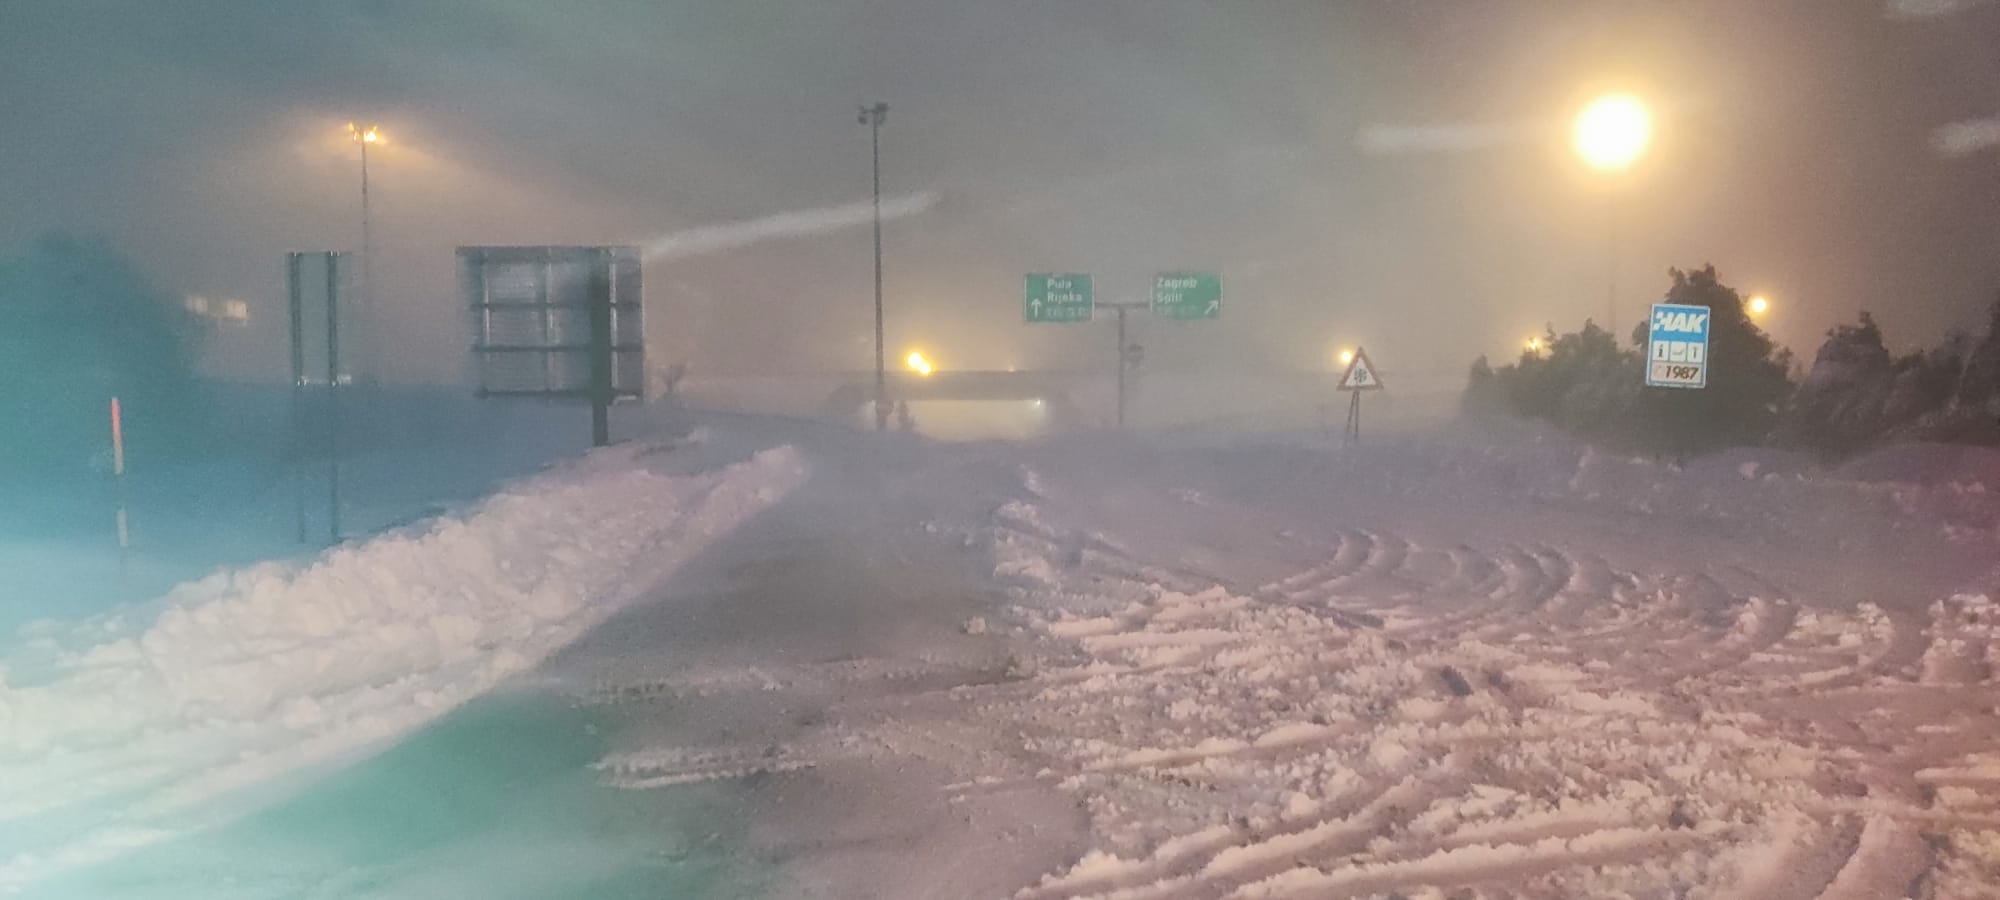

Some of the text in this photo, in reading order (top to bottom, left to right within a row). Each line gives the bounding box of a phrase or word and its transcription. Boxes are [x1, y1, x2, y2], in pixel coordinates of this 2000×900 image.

[1047, 278, 1072, 289] Pula
[1157, 277, 1197, 290] Zagreb
[1047, 291, 1082, 304] Rijeka
[1157, 291, 1183, 305] Split
[1653, 311, 1707, 333] HAK
[1666, 365, 1699, 380] 1987
